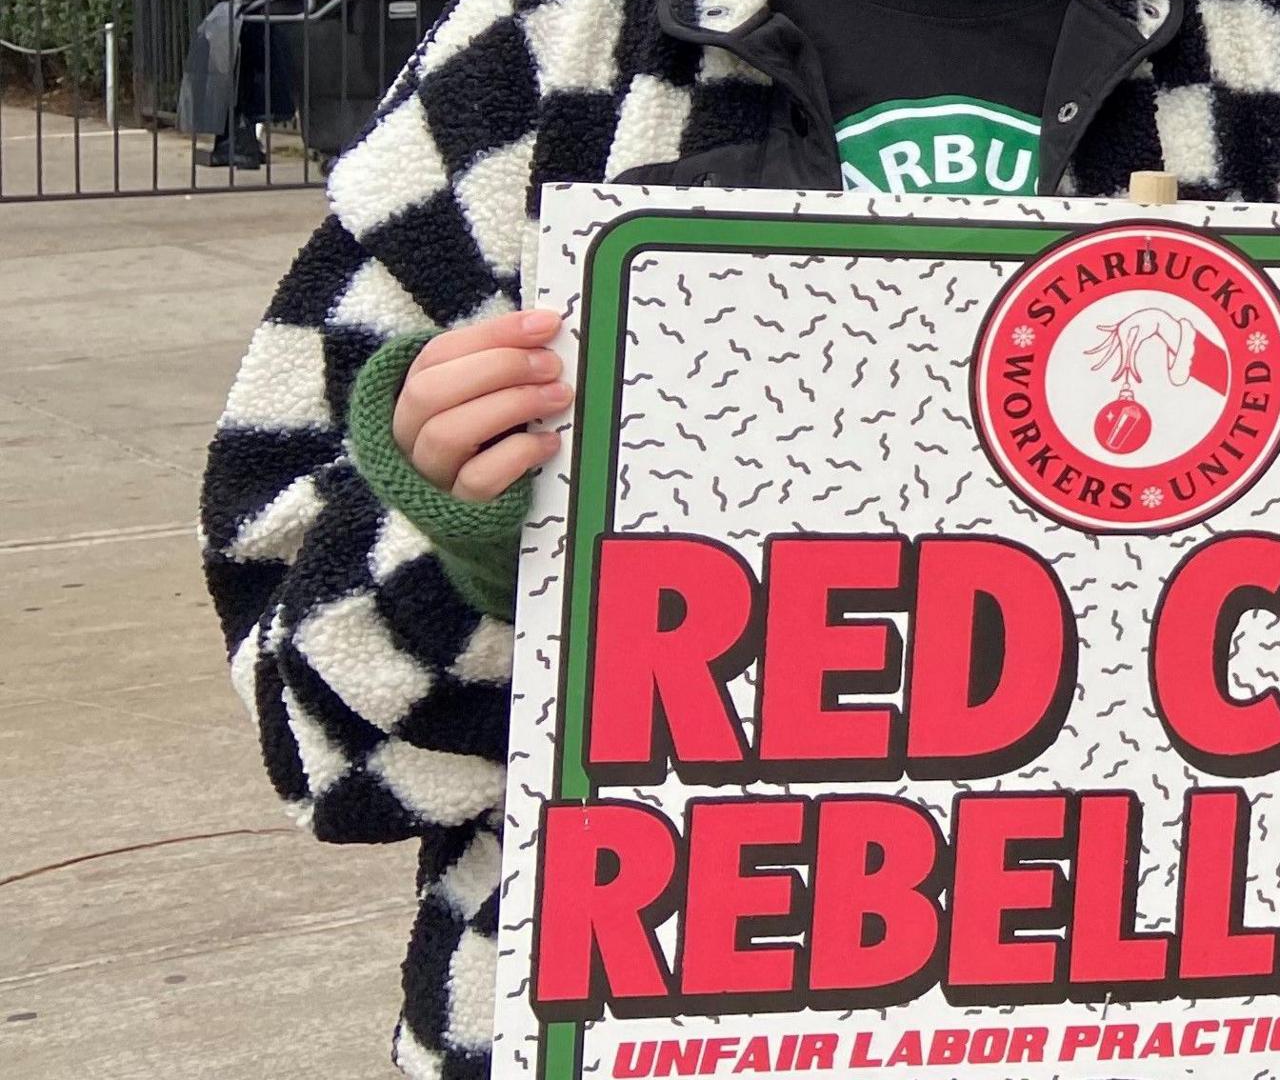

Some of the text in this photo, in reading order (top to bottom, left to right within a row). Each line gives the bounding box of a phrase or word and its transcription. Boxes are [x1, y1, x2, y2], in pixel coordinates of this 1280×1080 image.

[1027, 248, 1260, 330] STARBUCKS
[1003, 354, 1132, 509] WORKERS
[1168, 361, 1271, 501] UNITED
[584, 534, 1076, 782] RED
[611, 1033, 839, 1079] UNFAIR
[849, 1026, 1049, 1068] LABOR
